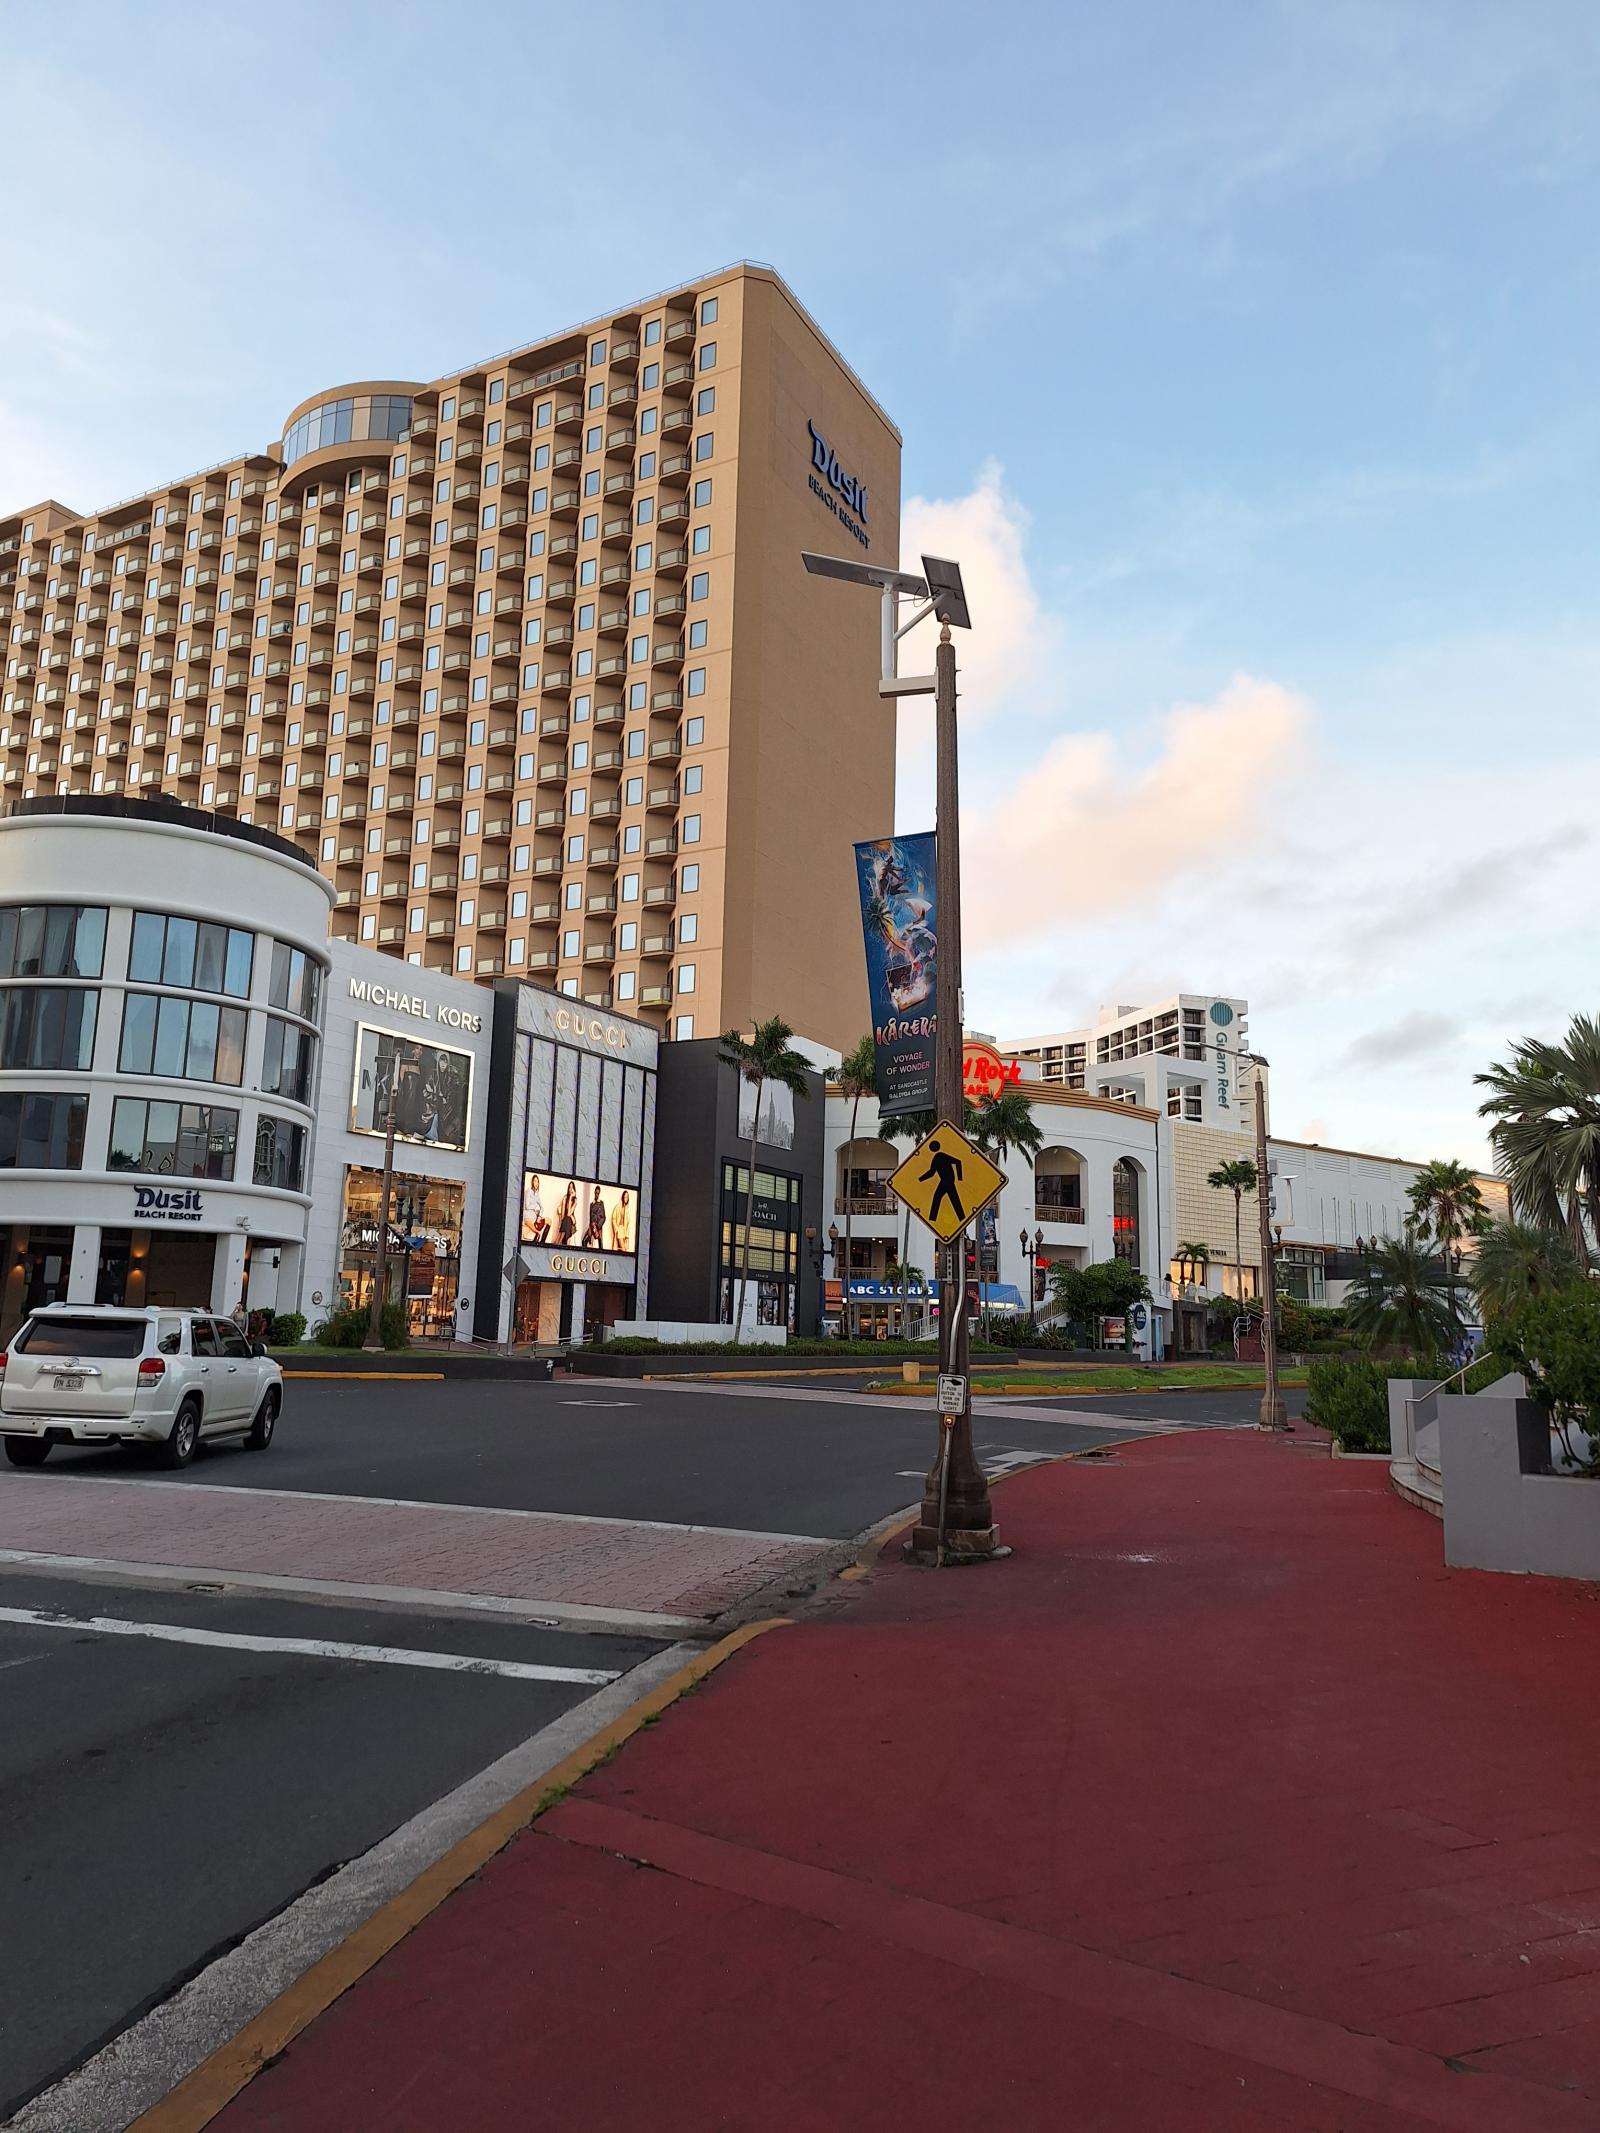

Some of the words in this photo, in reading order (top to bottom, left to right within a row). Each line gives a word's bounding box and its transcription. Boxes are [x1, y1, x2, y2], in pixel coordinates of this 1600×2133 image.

[808, 418, 869, 524] Dusit
[808, 473, 838, 515] BEACH
[839, 507, 870, 550] RESORT
[348, 977, 431, 1019] MICHAEL
[436, 1004, 482, 1033] KORS
[555, 1008, 627, 1050] GUCCI
[893, 1051, 924, 1064] VOYAGE
[886, 1067, 898, 1076] OF
[899, 1061, 931, 1074] WONDER
[973, 1057, 1022, 1086] Rock
[897, 1078, 928, 1090] SANDCASTLE
[911, 1087, 928, 1097] GROUP
[1217, 1078, 1230, 1110] Reef
[133, 1185, 204, 1211] Dusit
[134, 1210, 166, 1219] BEACH
[168, 1212, 203, 1221] RESORT
[362, 1229, 405, 1244] MICHA
[551, 1254, 608, 1275] GUCCI
[849, 1285, 875, 1295] ABC
